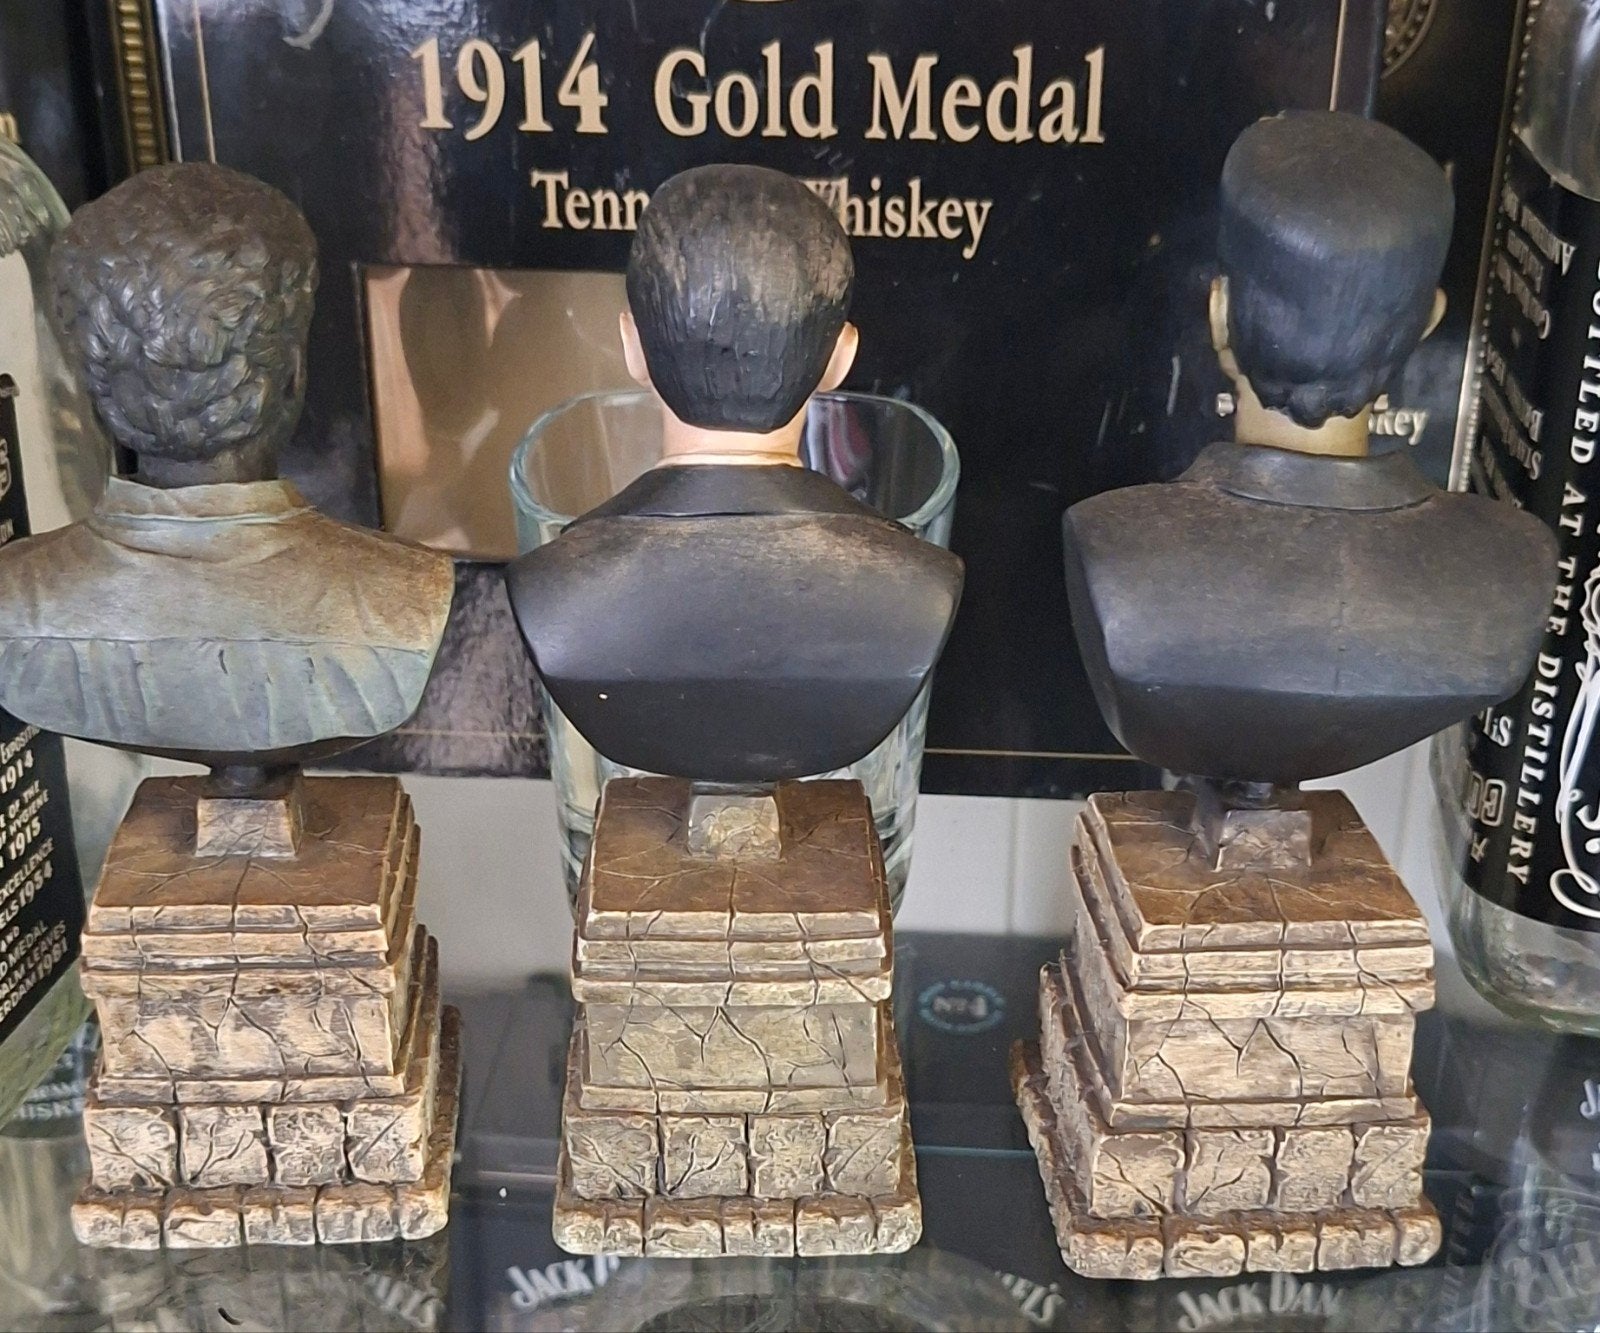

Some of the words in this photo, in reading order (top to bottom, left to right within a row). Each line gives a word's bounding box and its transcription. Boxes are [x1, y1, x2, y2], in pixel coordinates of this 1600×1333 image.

[411, 32, 609, 141] 1914
[654, 40, 838, 138] Gold
[866, 45, 1106, 144] Medal
[1559, 481, 1587, 537] AT
[1545, 556, 1578, 636] THE
[0, 749, 34, 794] 1914
[1507, 651, 1563, 885] DISTILLERY
[9, 788, 50, 836] HYGIENE
[8, 815, 42, 861] 1915
[19, 860, 53, 908] 1954
[8, 919, 49, 967] MEDAL
[26, 919, 66, 969] LEAVES
[510, 1258, 595, 1312] JACK
[1177, 1281, 1265, 1331] JACK
